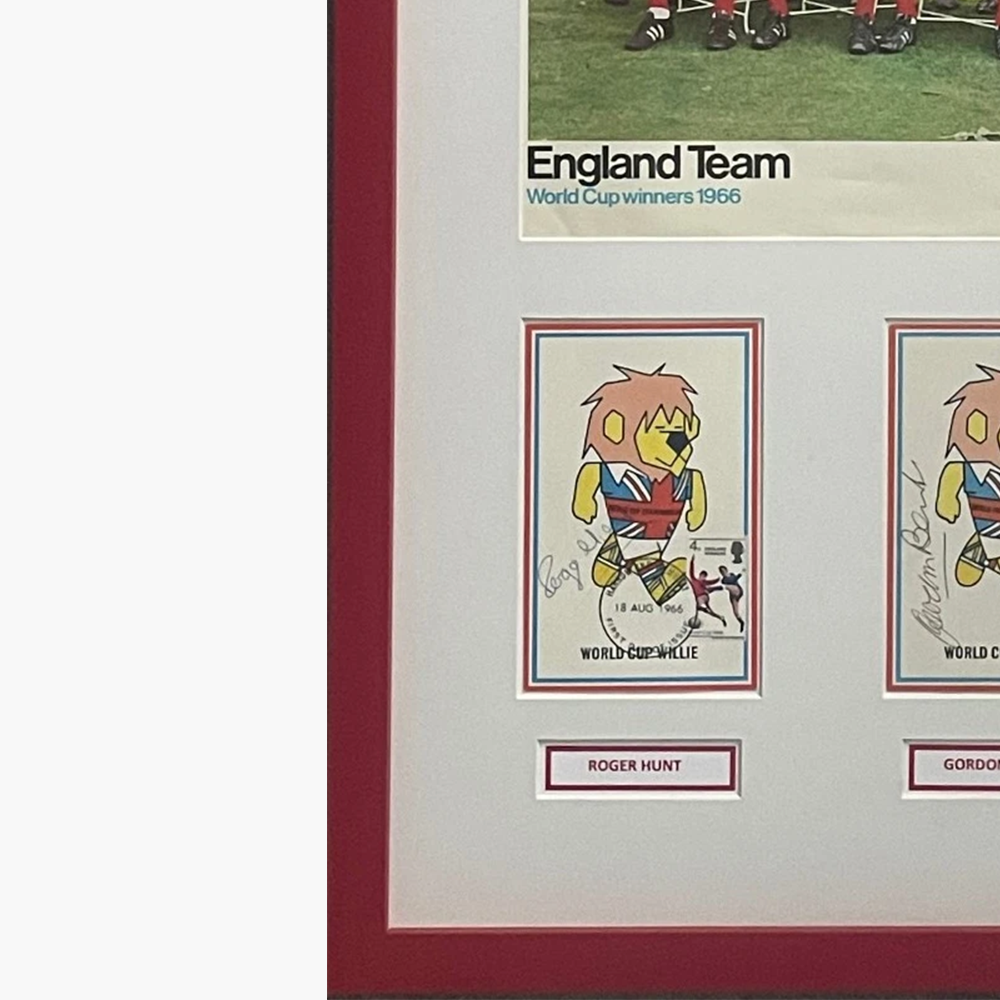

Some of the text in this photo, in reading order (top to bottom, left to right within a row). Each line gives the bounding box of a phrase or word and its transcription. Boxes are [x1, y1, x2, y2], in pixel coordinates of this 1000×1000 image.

[527, 145, 791, 187] England Team
[526, 188, 741, 207] World Cup winners 1966
[615, 603, 684, 614] 18 AUG 1966
[580, 647, 624, 660] WORLD
[627, 647, 653, 660] CUP
[658, 645, 699, 660] WILLIE
[944, 646, 988, 659] WORLD
[588, 758, 682, 772] ROGER HUNT
